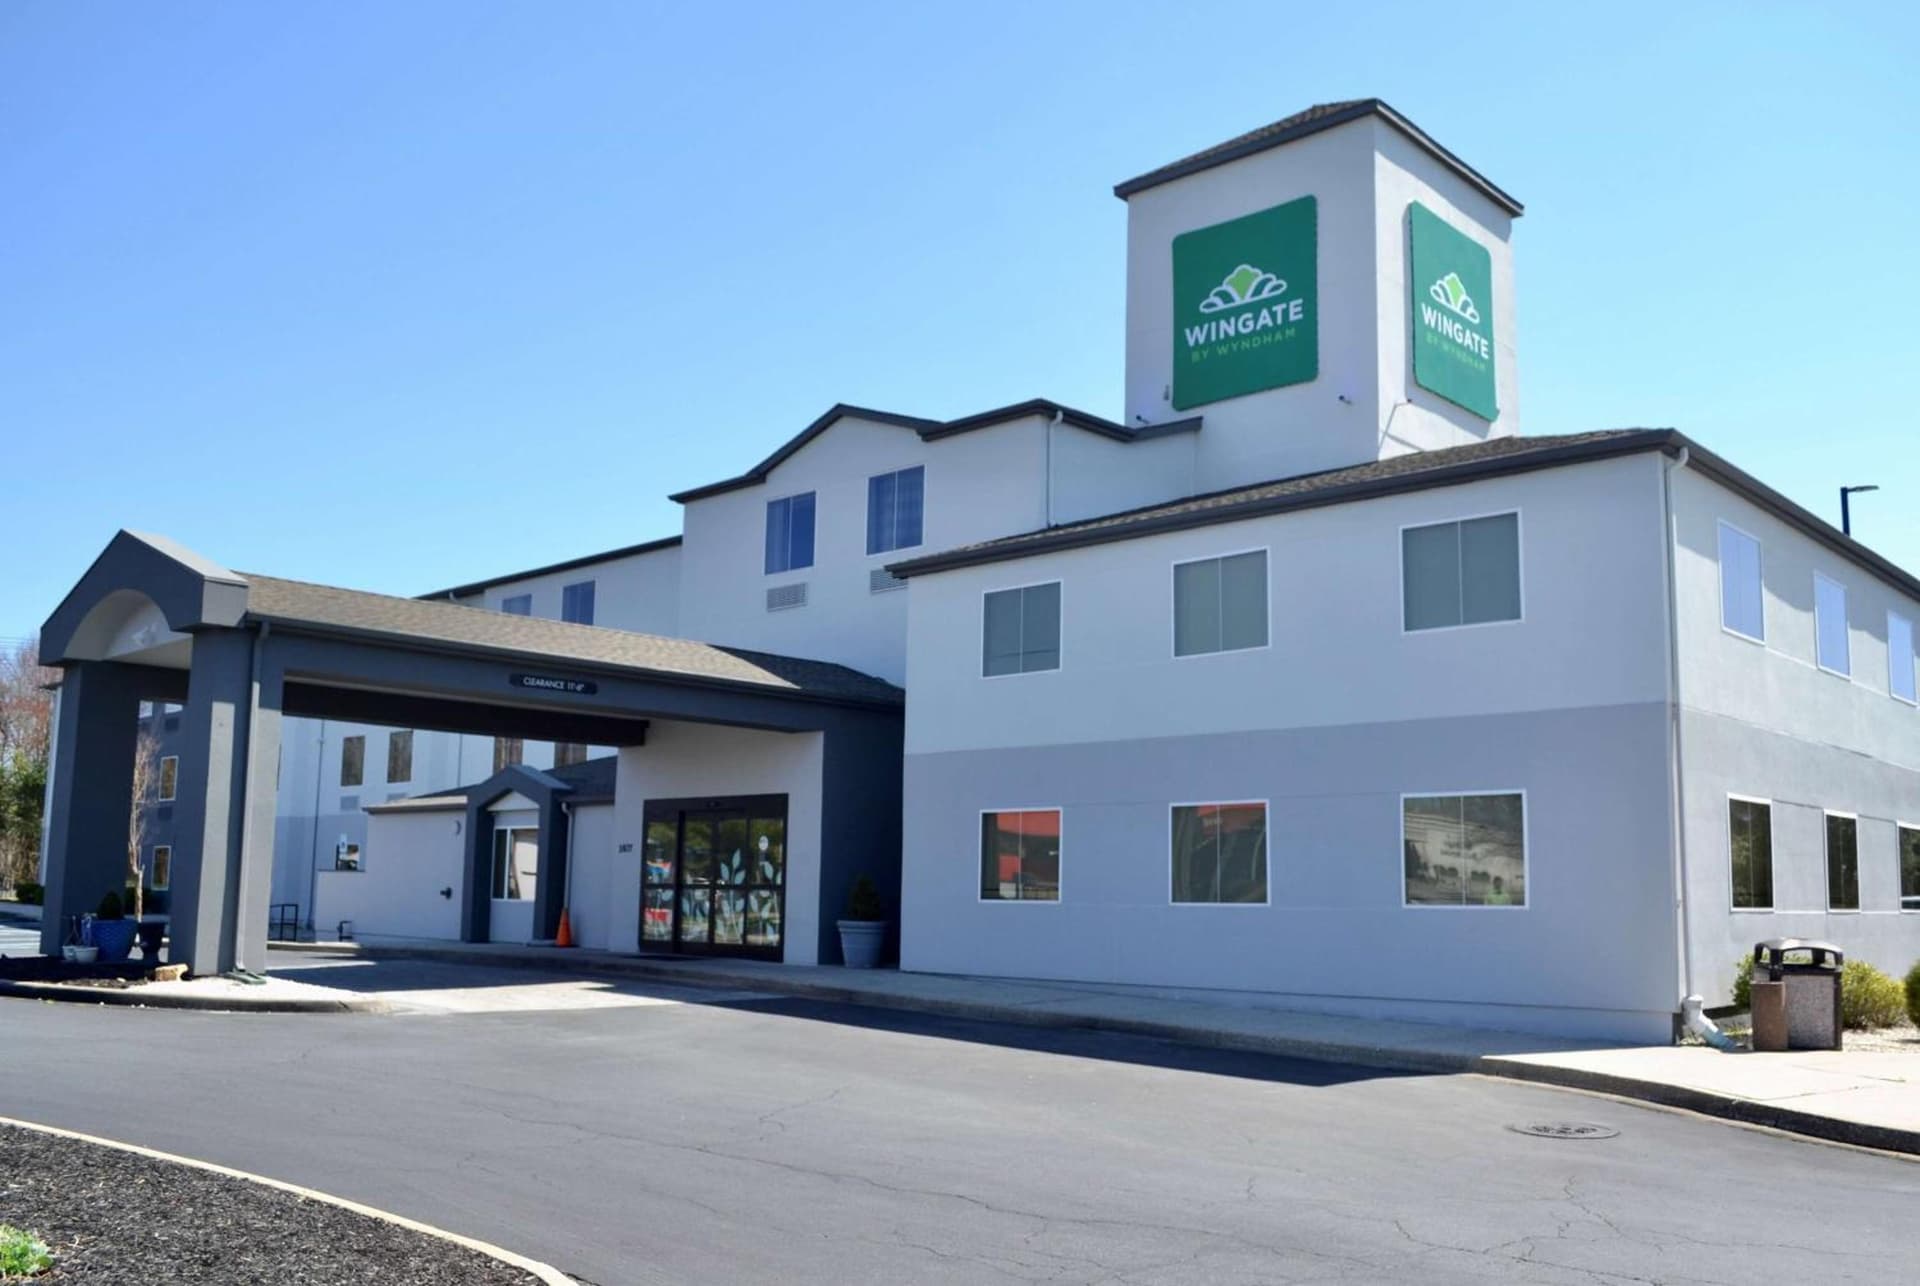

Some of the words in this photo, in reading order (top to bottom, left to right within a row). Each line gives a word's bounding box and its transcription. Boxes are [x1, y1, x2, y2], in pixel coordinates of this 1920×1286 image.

[1184, 298, 1304, 347] WINGATE
[1421, 302, 1489, 360] WINGATE
[1192, 350, 1209, 363] BY
[1216, 327, 1296, 356] WYNDHAM
[523, 677, 564, 689] CLEARANCE
